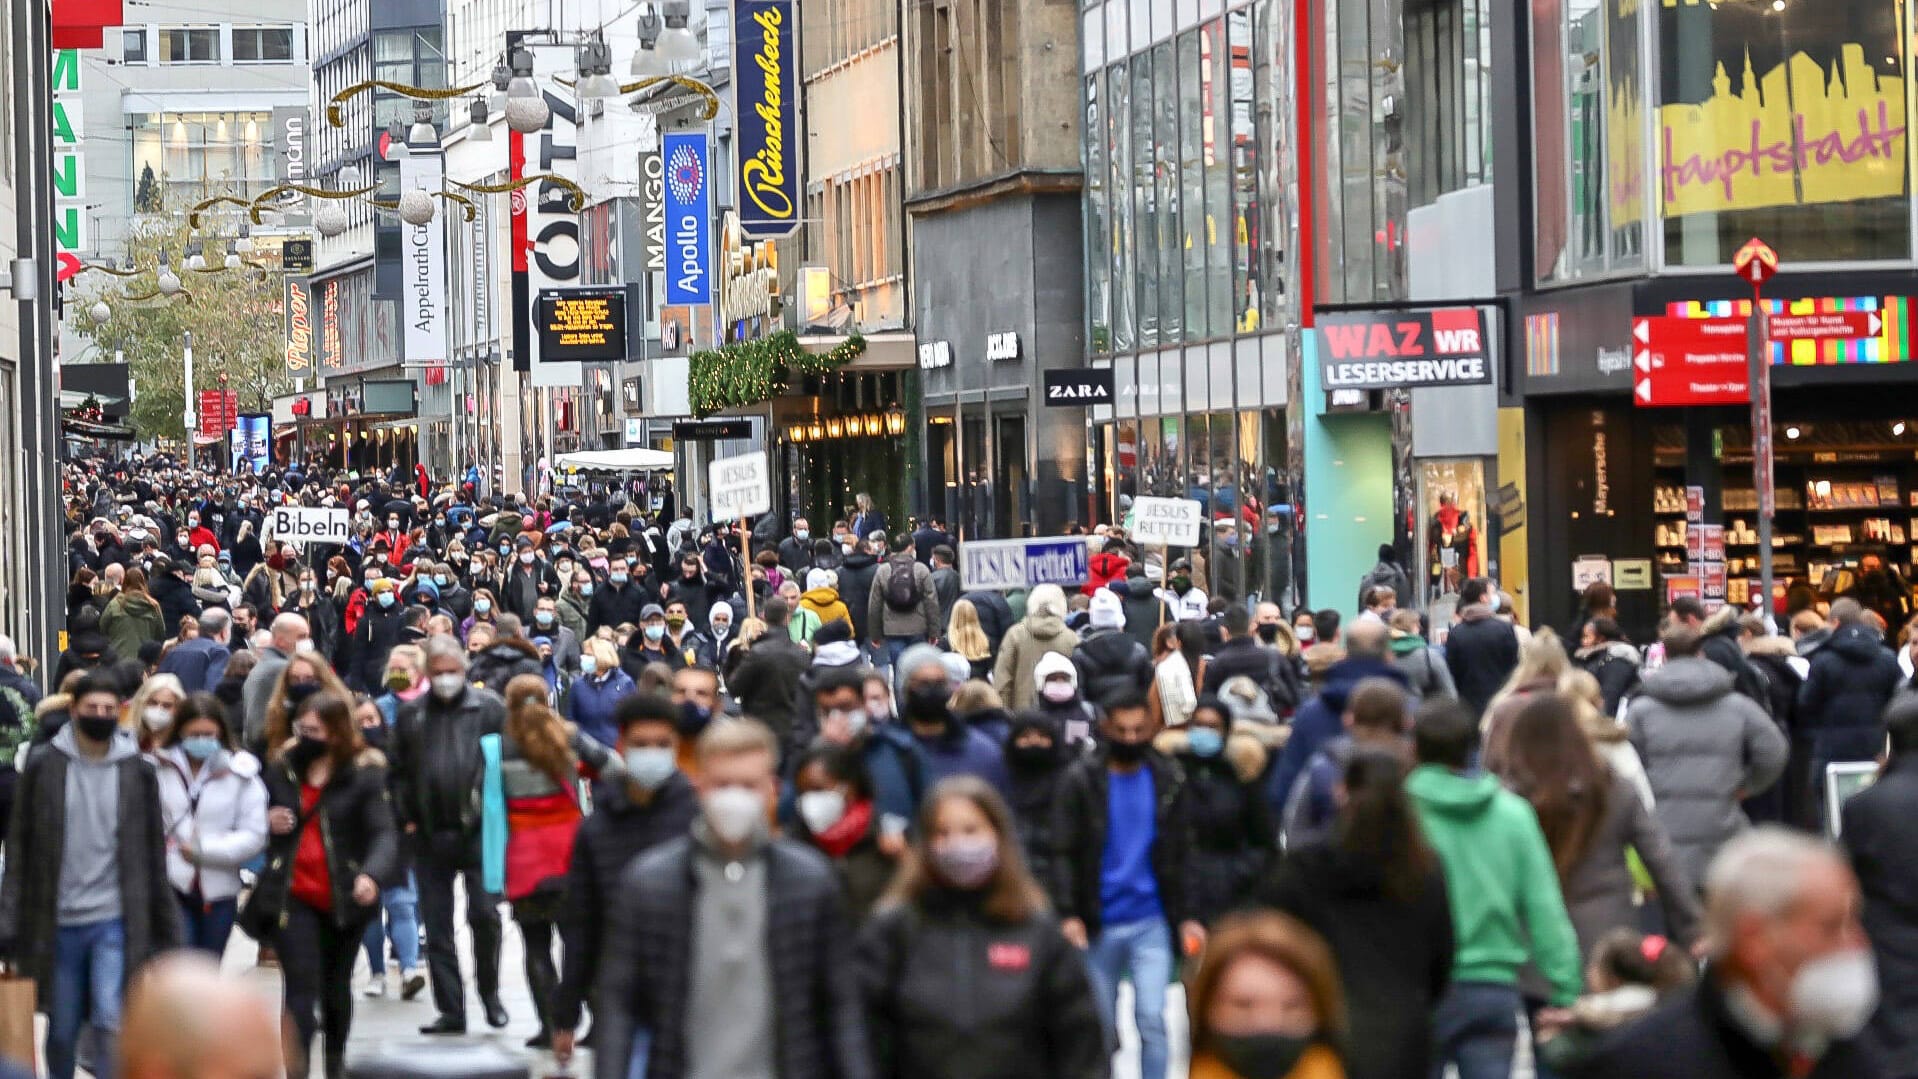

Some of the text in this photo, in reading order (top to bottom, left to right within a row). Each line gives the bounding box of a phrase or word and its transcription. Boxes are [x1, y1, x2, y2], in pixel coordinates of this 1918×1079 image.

[644, 155, 665, 268] MANGO
[676, 215, 704, 294] Apollo
[287, 282, 312, 371] Pieper
[1324, 322, 1480, 359] WAZ WR
[1326, 358, 1485, 384] LESERSERVICE
[1049, 384, 1108, 398] ZARA
[720, 462, 757, 485] JESUS
[717, 485, 760, 507] RETTET
[276, 511, 347, 536] Bibeln
[1146, 504, 1189, 520] JESUS
[1140, 520, 1192, 537] RETTET
[967, 547, 1024, 584] JESUS
